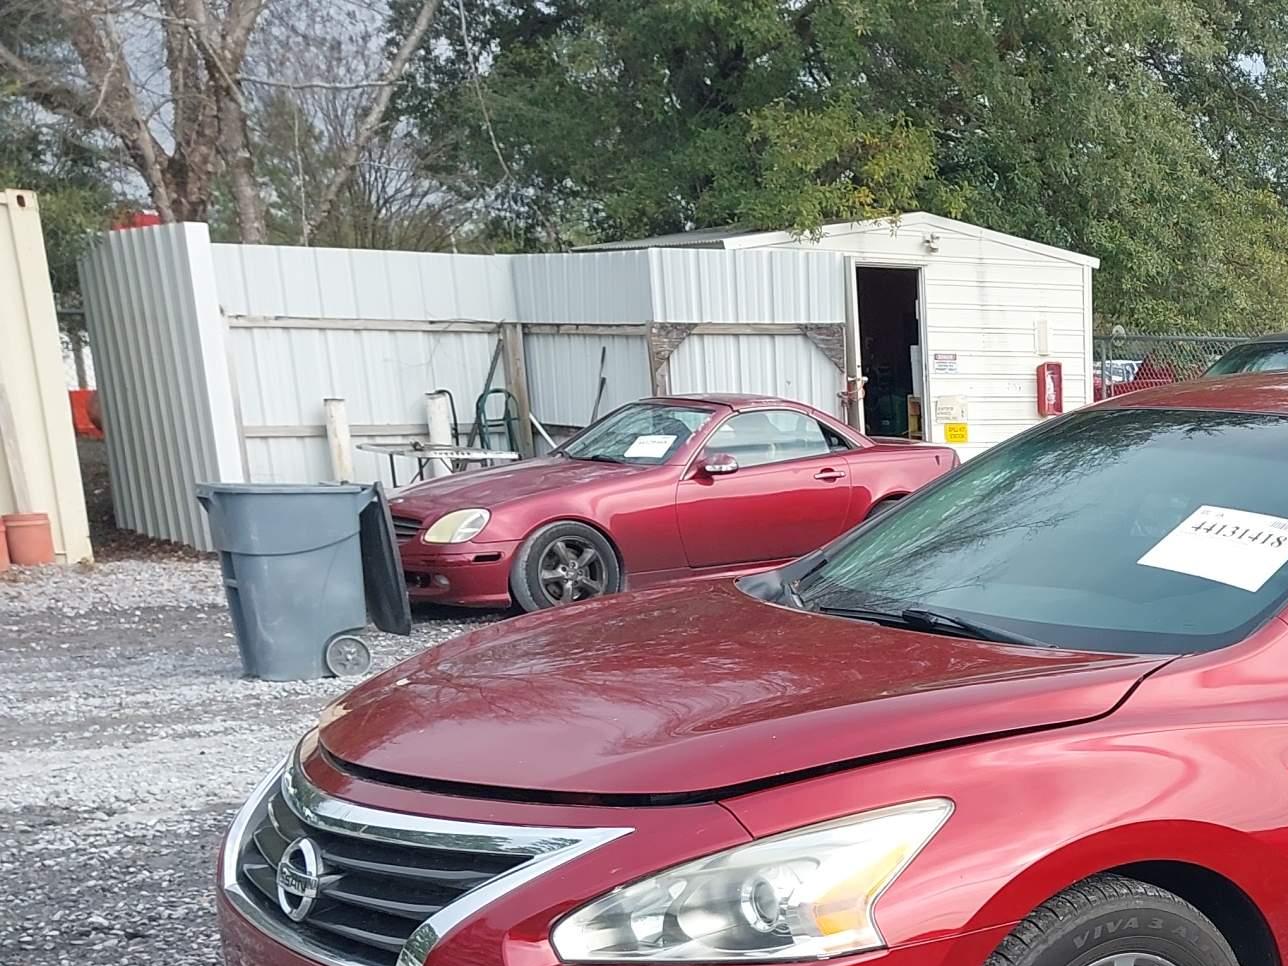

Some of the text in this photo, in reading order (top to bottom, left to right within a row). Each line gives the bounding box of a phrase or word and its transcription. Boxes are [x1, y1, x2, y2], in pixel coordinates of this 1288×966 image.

[1193, 521, 1288, 548] 44131418
[1073, 916, 1139, 949] VIVA
[1149, 916, 1165, 929] 3
